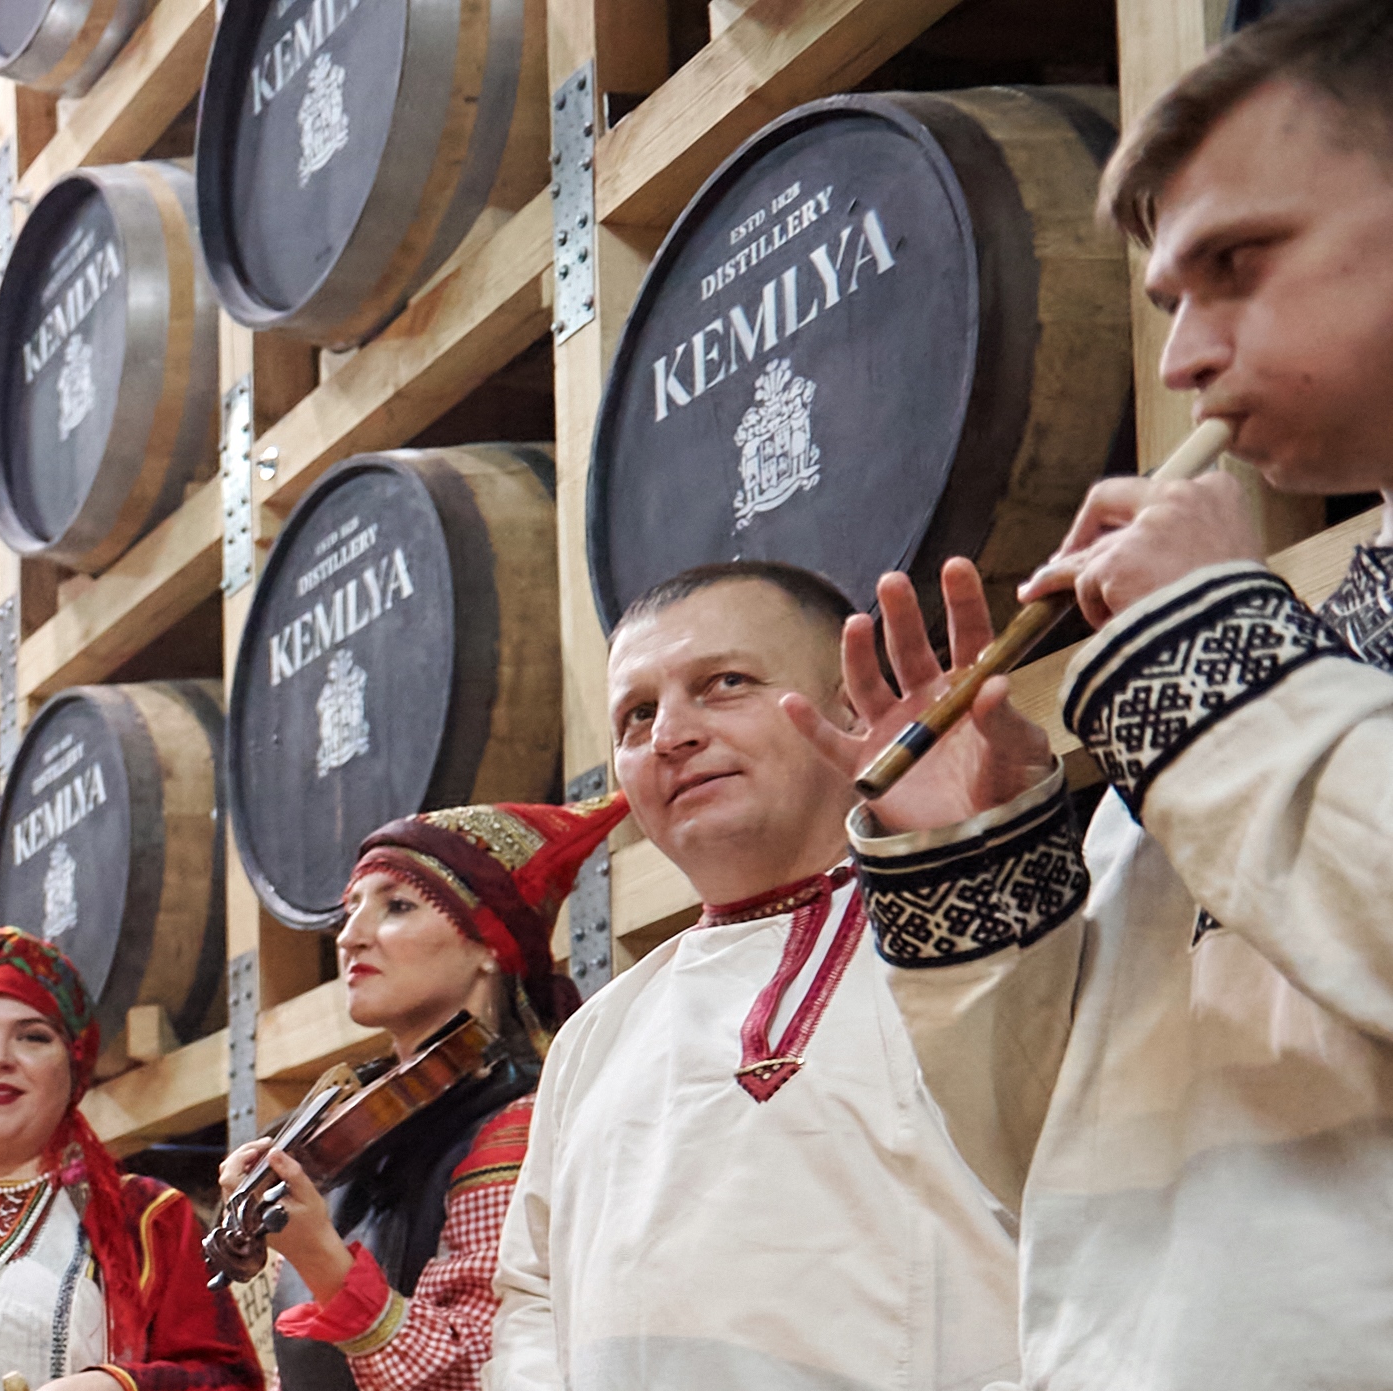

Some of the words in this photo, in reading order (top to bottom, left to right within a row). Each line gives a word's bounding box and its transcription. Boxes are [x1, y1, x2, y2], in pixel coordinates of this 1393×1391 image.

[252, 0, 359, 116] KEML
[700, 185, 834, 301] DISTILLERY
[24, 241, 121, 383] KEMLYA
[652, 209, 897, 423] KEMLYA
[269, 547, 415, 688] KEMLYA
[14, 762, 107, 867] KEMLYA
